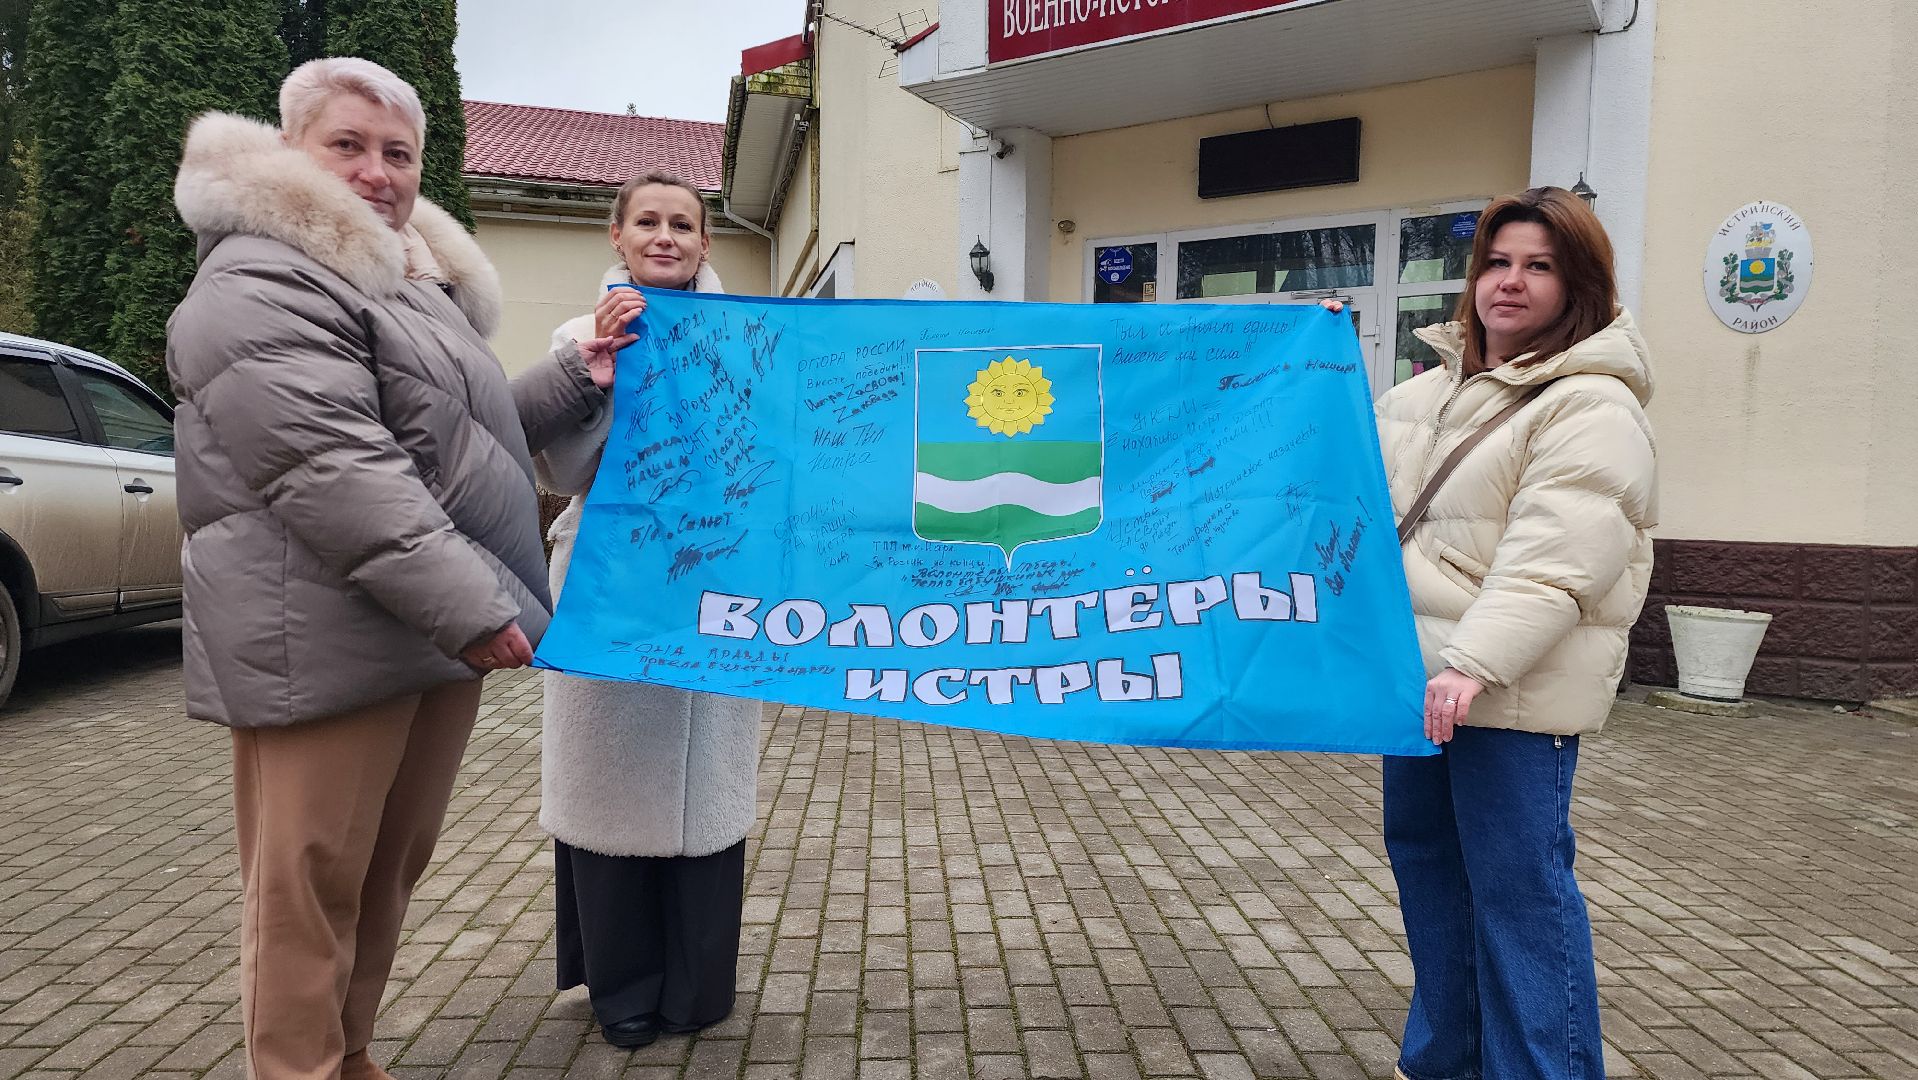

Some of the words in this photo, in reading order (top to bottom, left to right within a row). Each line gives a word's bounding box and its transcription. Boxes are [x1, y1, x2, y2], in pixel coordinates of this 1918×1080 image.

[1718, 204, 1801, 237] ИСТРИНСКИЙ
[1733, 315, 1778, 330] РАЙОН
[797, 351, 846, 372] ОПОРА
[855, 339, 906, 361] РОССИИ
[699, 565, 1318, 648] ВОЛОНТЁРЫ
[843, 651, 1183, 706] ИСТРЫ
